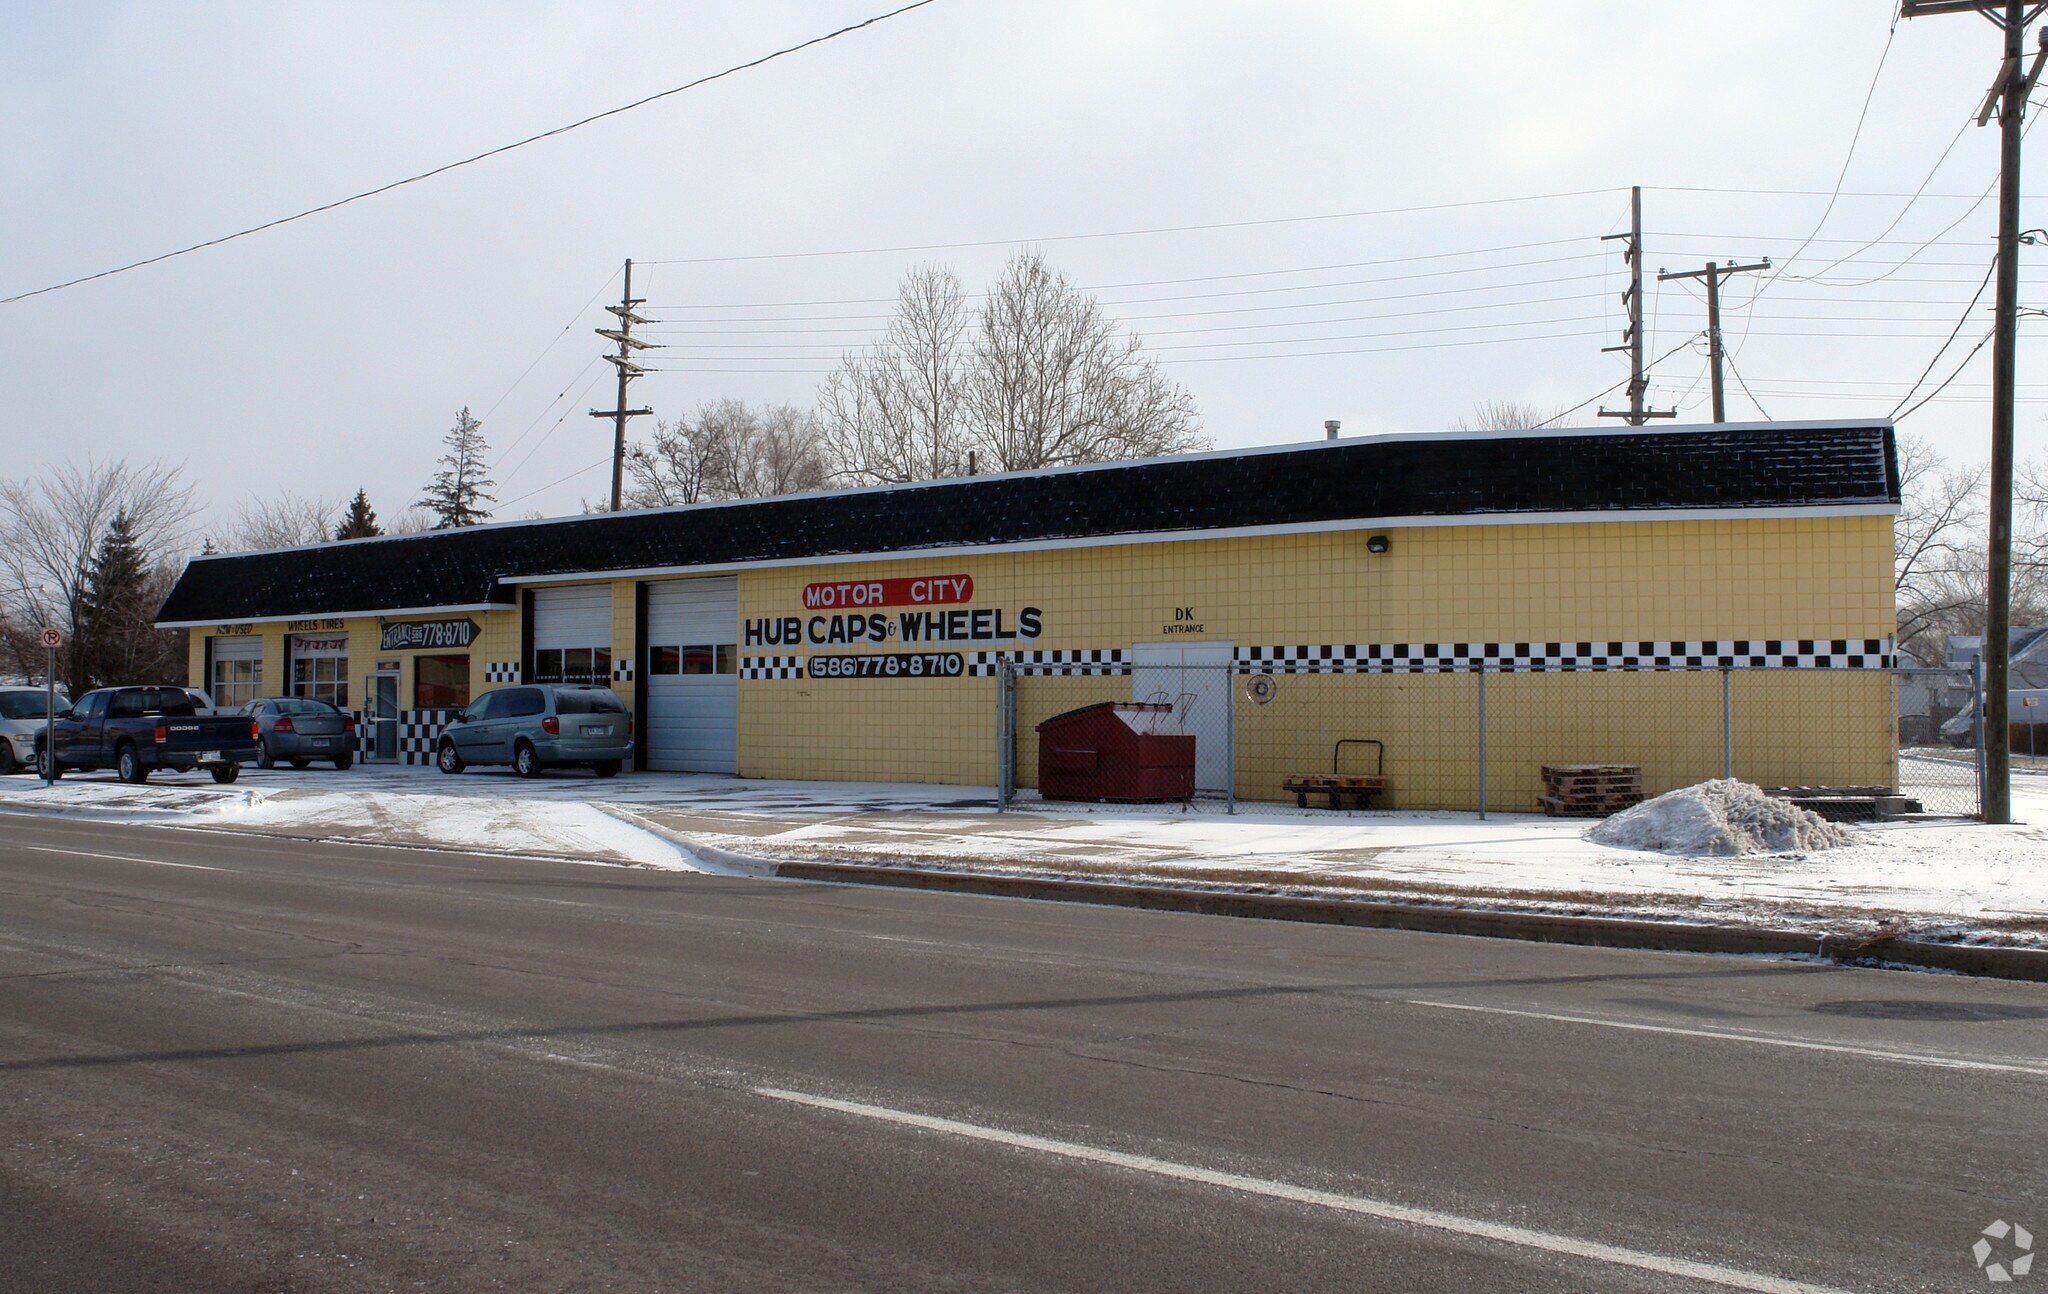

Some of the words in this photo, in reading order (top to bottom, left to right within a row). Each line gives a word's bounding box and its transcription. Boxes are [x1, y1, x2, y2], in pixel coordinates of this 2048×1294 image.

[806, 583, 884, 607] MOTOR
[911, 578, 968, 602] CITY
[1175, 607, 1194, 621] DK
[234, 623, 253, 635] USED
[288, 620, 318, 632] WHEELS
[320, 618, 345, 630] TIRES
[744, 617, 802, 647] HUB
[808, 613, 888, 644] CAPS
[887, 618, 897, 637] &
[899, 607, 1043, 642] WHEELS
[1162, 624, 1205, 634] ENTRANCE
[383, 623, 412, 649] ENTRANCE
